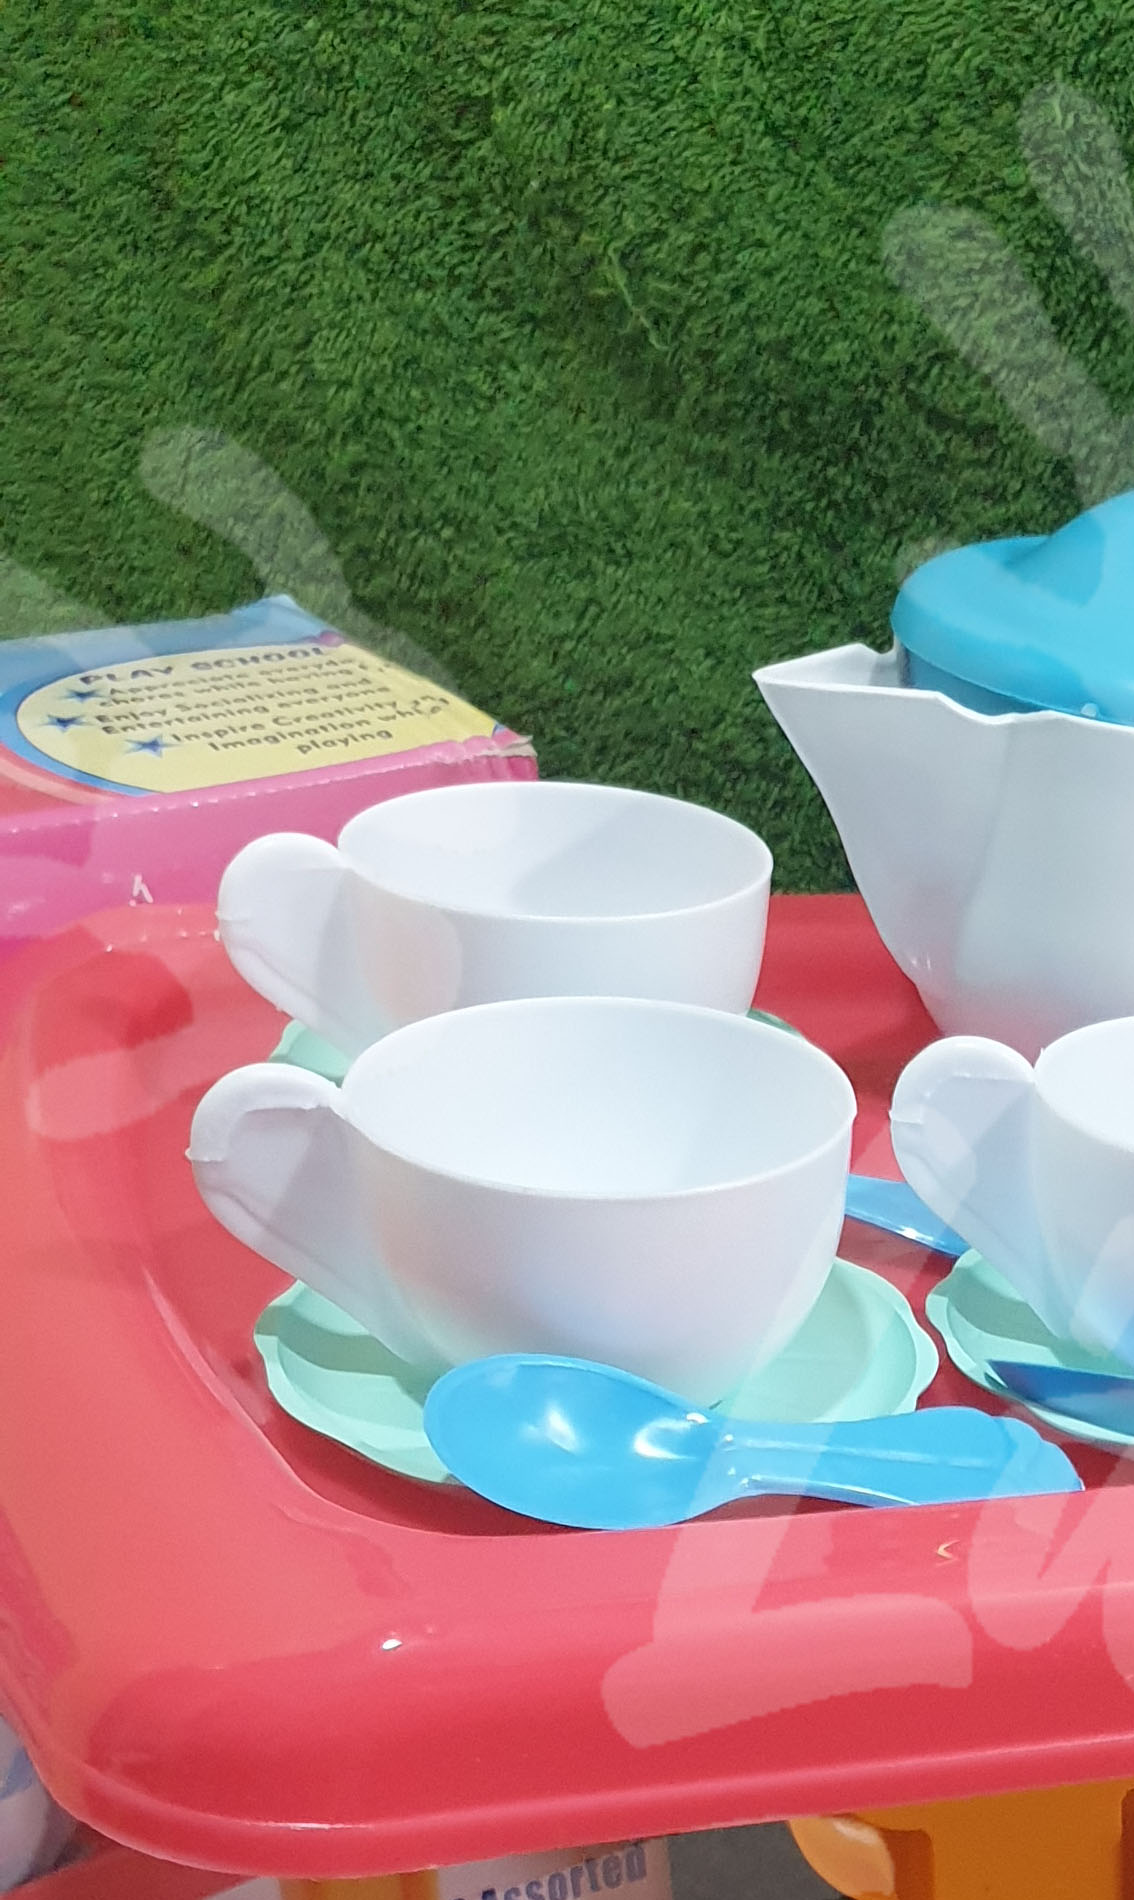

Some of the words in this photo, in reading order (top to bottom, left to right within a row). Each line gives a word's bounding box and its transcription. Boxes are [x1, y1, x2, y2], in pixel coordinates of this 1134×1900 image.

[79, 663, 174, 687] PLAY
[191, 646, 328, 672] SCHOOL
[109, 670, 250, 698] Appreciate
[95, 706, 168, 728] Enjoy
[178, 685, 309, 714] Socializing
[317, 677, 373, 697] and
[100, 688, 185, 709] chores
[267, 668, 354, 687] having
[101, 703, 270, 736] Entertaining
[276, 685, 392, 712] everyone
[171, 718, 265, 743] Inspire
[272, 699, 398, 727] Creativity
[208, 715, 371, 753] Imagination
[297, 728, 394, 756] playing
